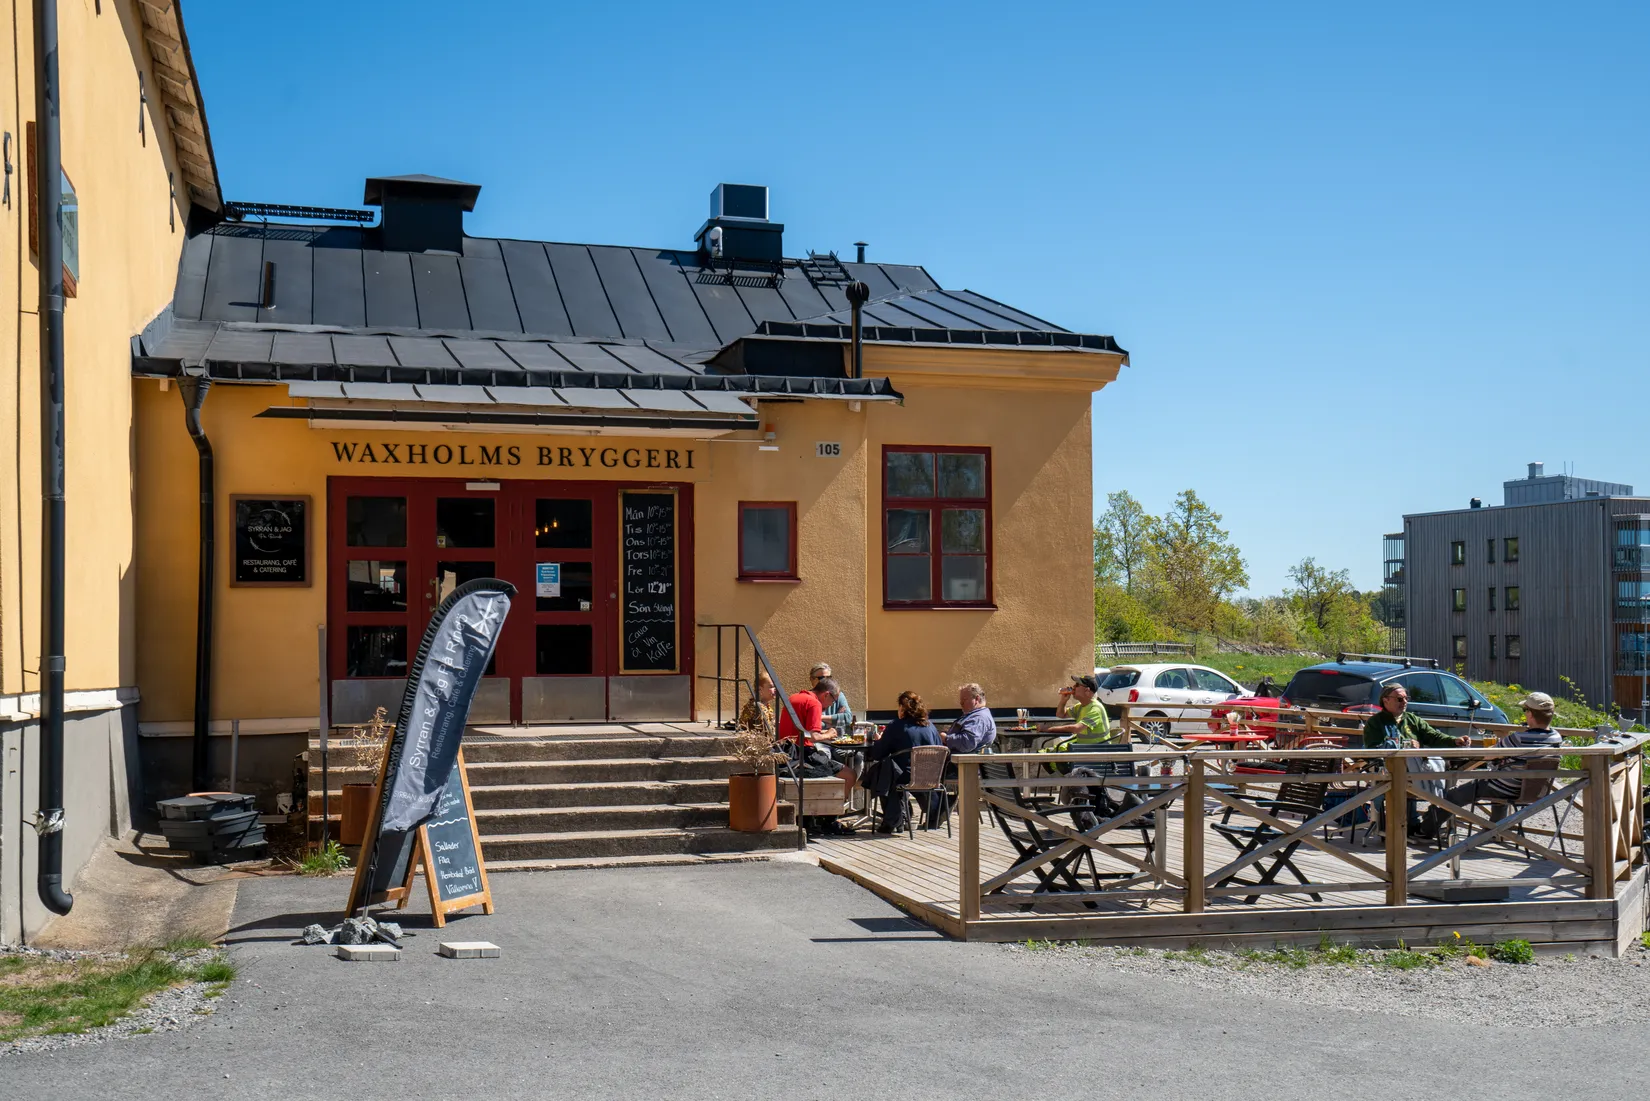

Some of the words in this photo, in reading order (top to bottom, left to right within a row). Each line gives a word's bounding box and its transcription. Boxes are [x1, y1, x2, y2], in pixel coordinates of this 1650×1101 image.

[331, 442, 521, 466] WAXHOLMS
[537, 446, 695, 469] BRYGGERI
[819, 443, 840, 456] 105
[625, 523, 643, 535] Tis
[625, 537, 646, 547] Ons
[626, 549, 649, 560] Tors
[627, 564, 643, 576] Fre
[628, 582, 644, 594] Lör
[628, 600, 651, 614] Sön
[445, 613, 468, 653] Rindö
[628, 625, 649, 644] Cava
[646, 641, 673, 662] Kaffe
[437, 656, 454, 675] På
[431, 710, 455, 759] Restaurang,
[448, 682, 461, 707] Café
[458, 644, 478, 678] Catering
[424, 707, 437, 717] &
[409, 721, 432, 767] Syrran
[435, 842, 459, 852] Sallader
[438, 856, 451, 865] Fika
